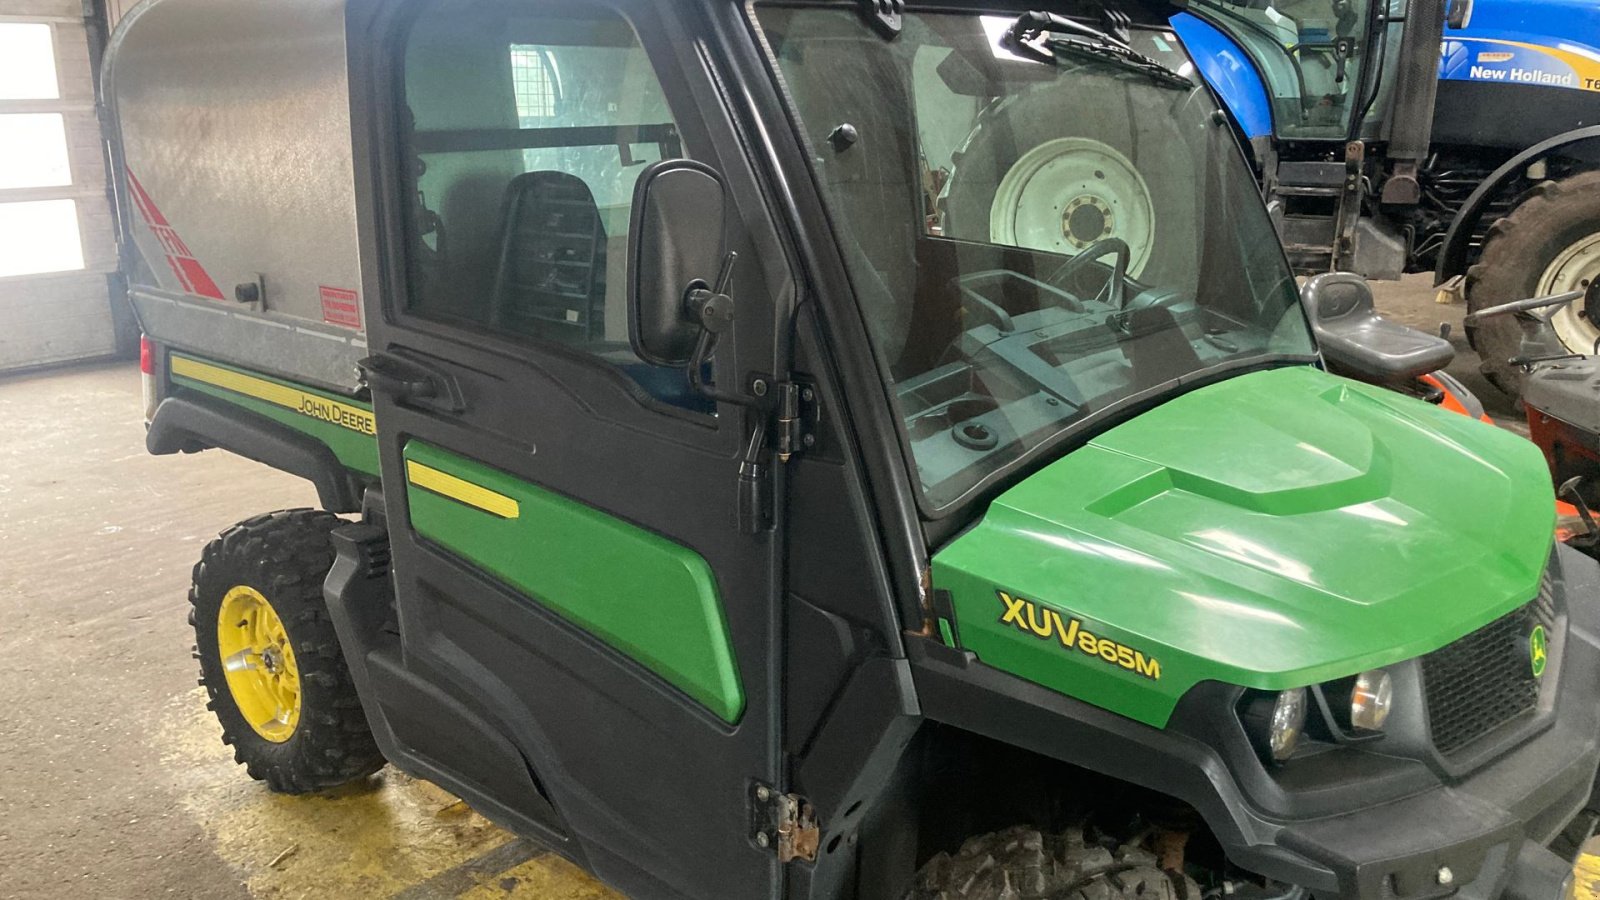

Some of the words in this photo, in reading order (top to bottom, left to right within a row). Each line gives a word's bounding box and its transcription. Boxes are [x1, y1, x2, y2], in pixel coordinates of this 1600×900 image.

[1470, 66, 1506, 79] New
[1510, 68, 1572, 85] Holland
[299, 395, 330, 419] JOHN
[332, 404, 373, 432] DEERE
[998, 590, 1162, 680] XUV865M
